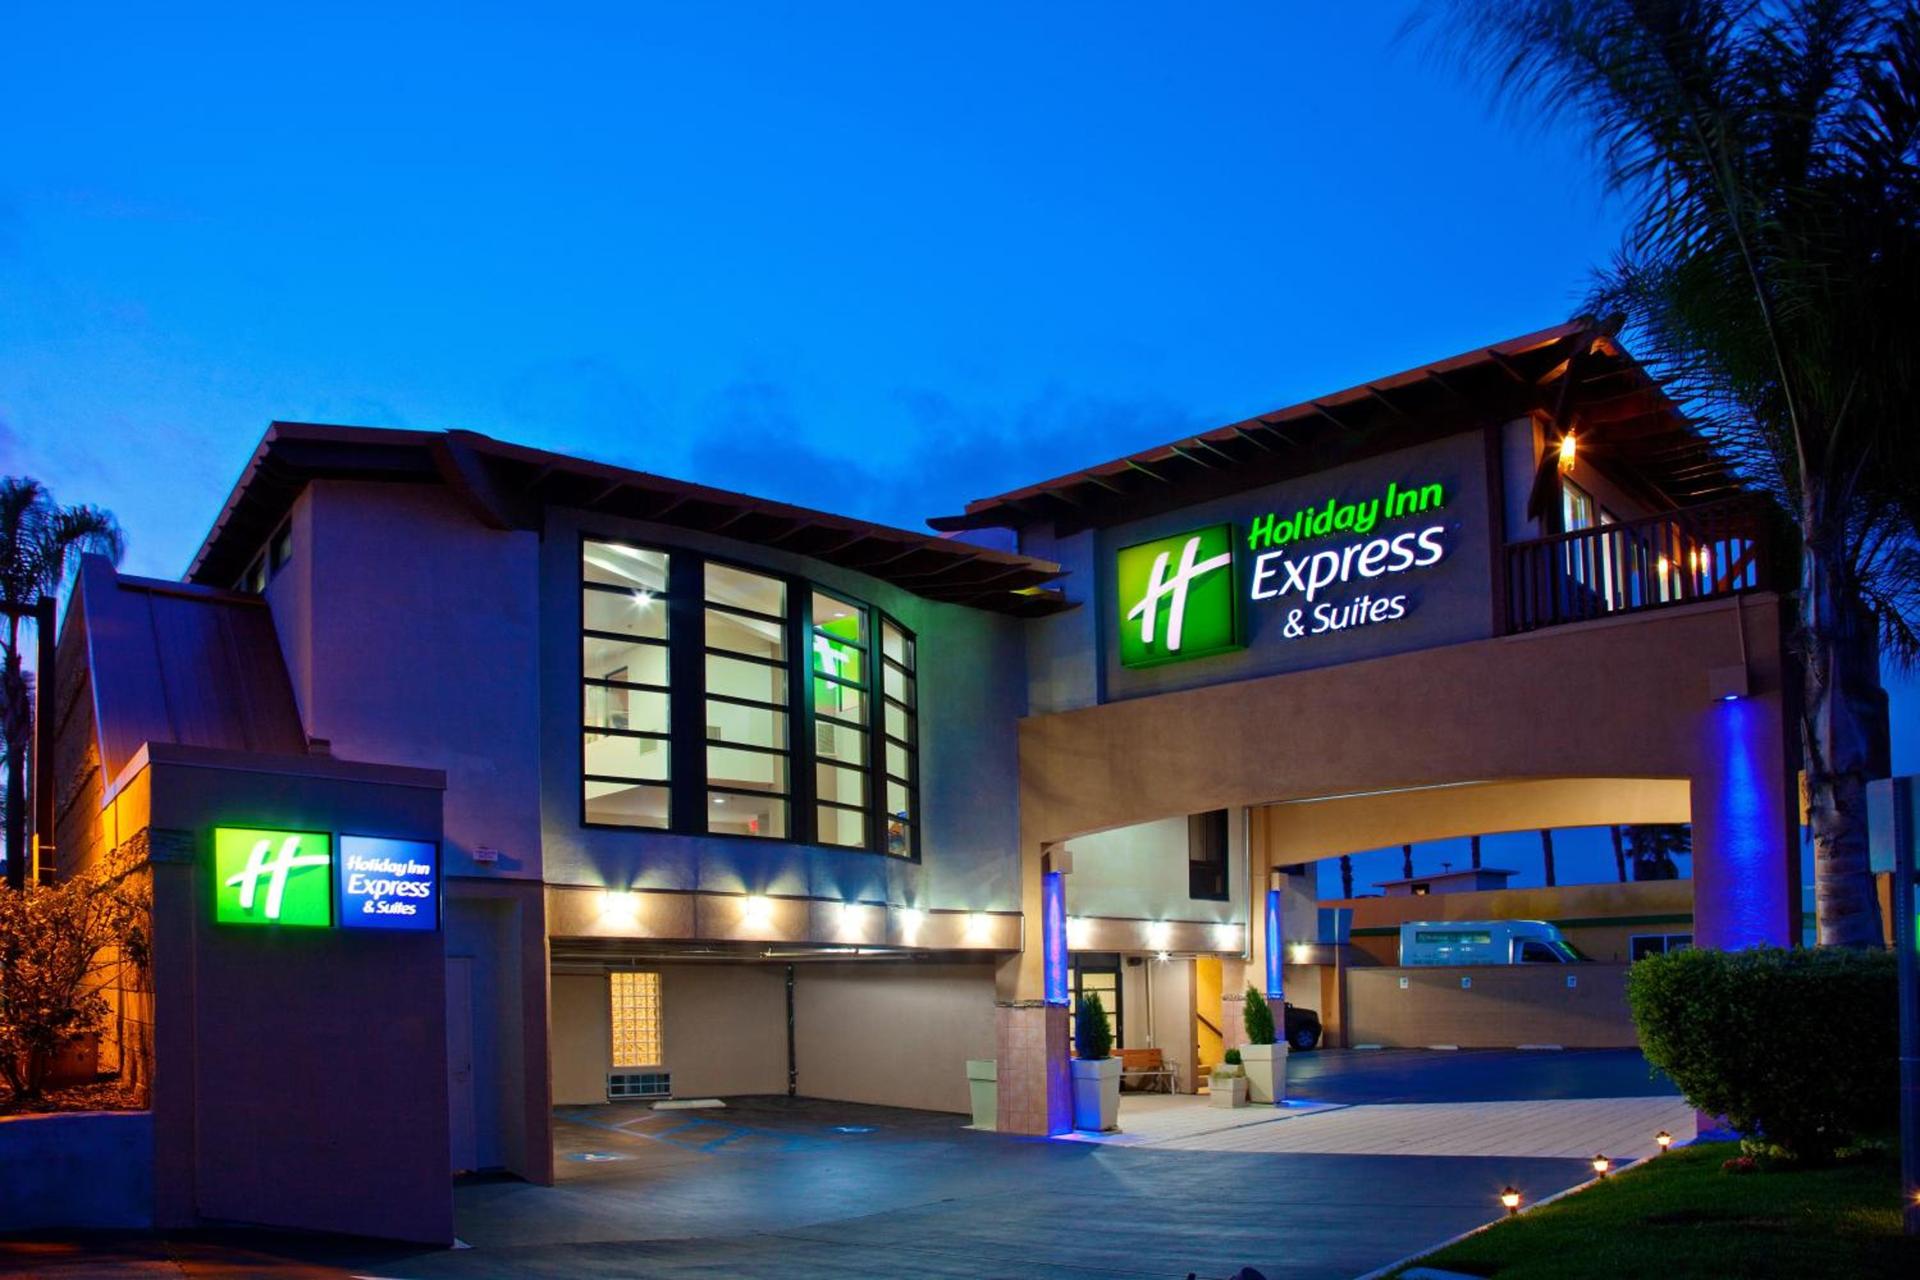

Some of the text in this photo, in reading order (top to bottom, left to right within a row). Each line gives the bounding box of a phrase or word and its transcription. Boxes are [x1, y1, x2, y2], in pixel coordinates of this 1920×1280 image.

[1247, 482, 1443, 550] Holiday Inn
[1250, 526, 1445, 602] Express
[1282, 594, 1406, 639] & Suites
[347, 855, 431, 877] Holiday Inn
[347, 873, 431, 900] Express
[362, 900, 417, 916] & Suites
